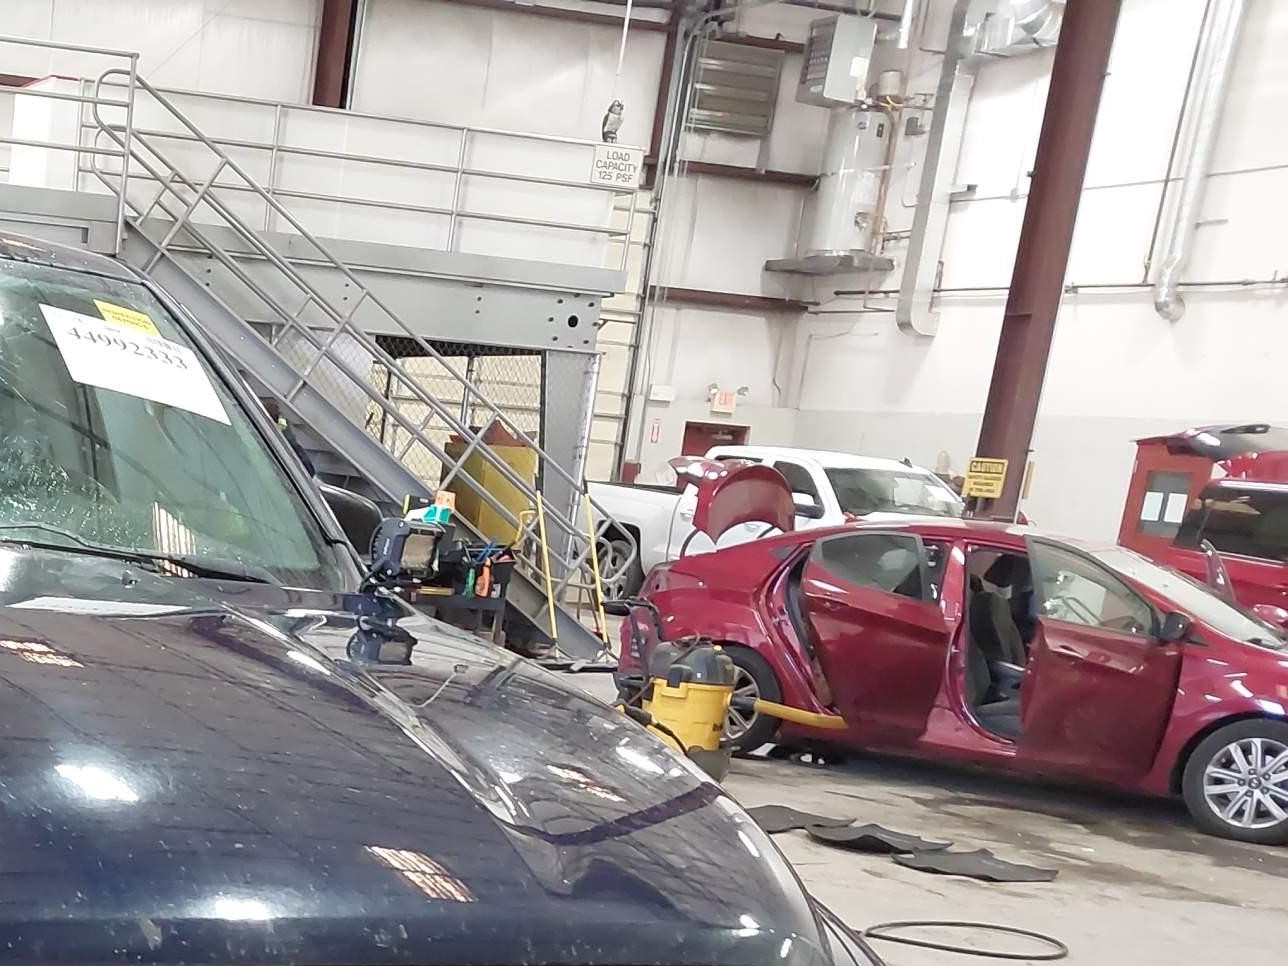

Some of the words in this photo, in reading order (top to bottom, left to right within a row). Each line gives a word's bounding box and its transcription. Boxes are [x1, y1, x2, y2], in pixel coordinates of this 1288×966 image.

[607, 151, 630, 161] LOAD
[596, 160, 637, 173] CAPACITY
[599, 171, 612, 180] 125
[616, 173, 633, 183] PSF
[67, 327, 188, 369] 44992333
